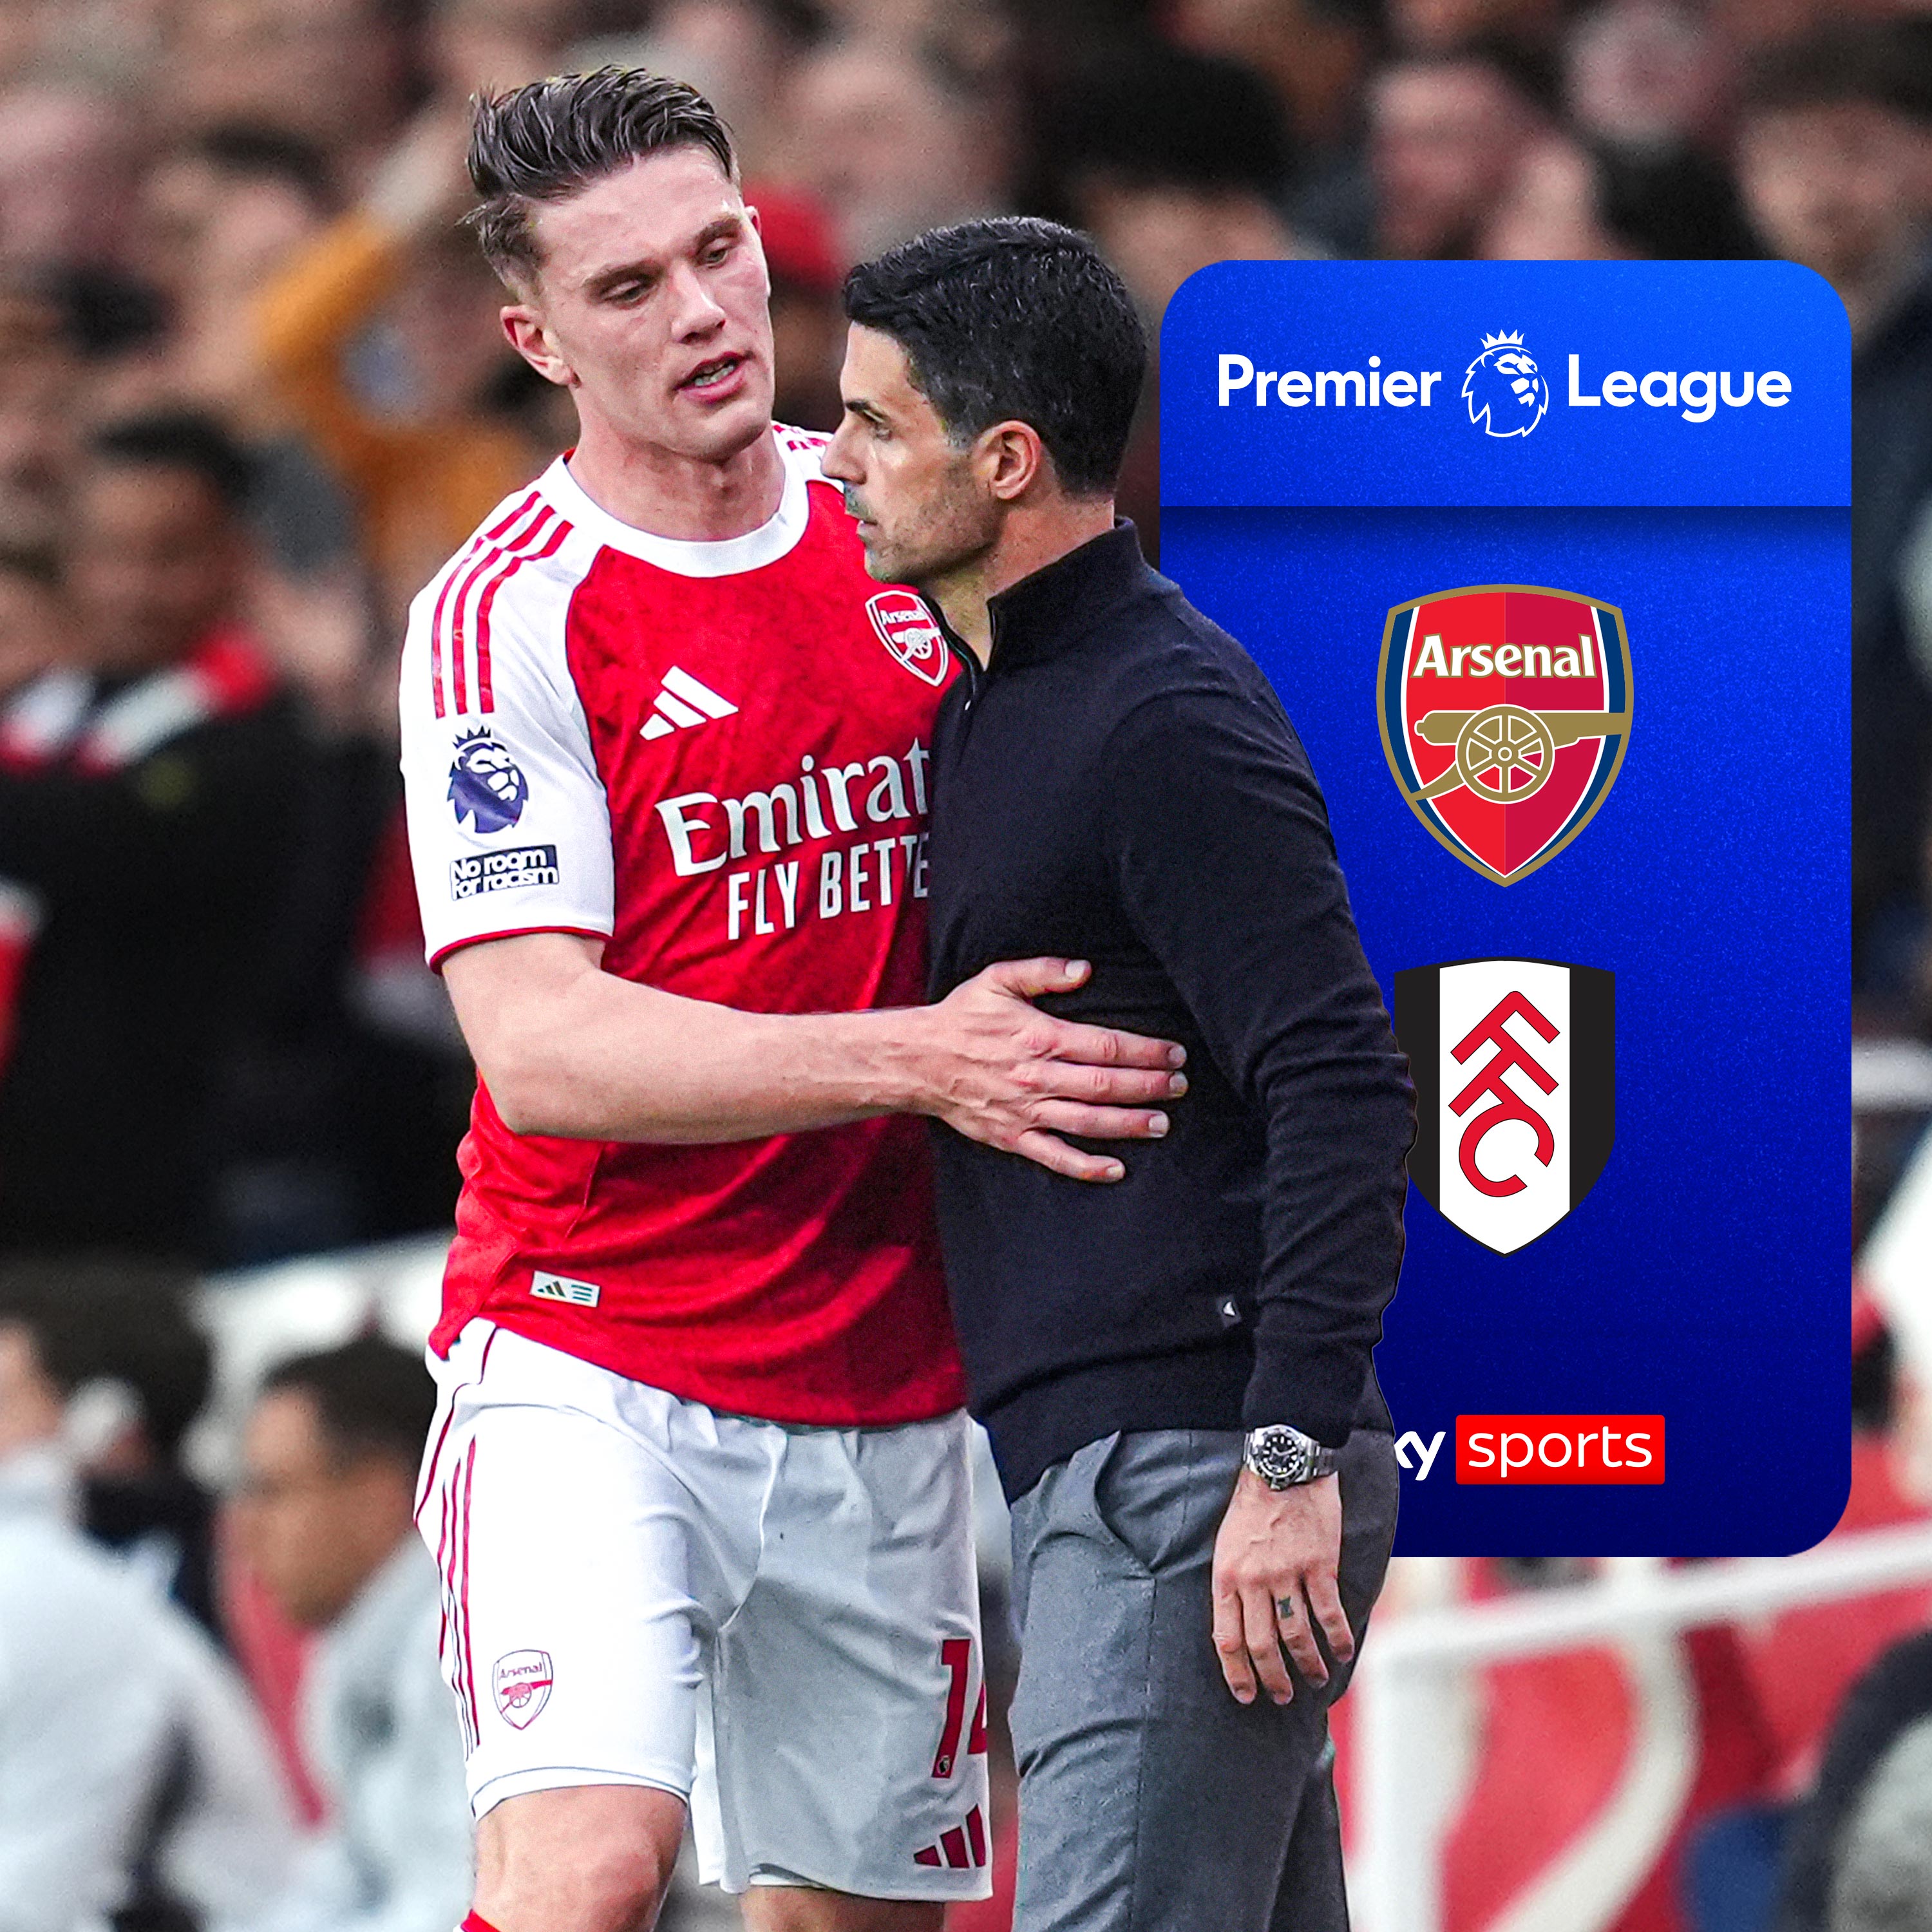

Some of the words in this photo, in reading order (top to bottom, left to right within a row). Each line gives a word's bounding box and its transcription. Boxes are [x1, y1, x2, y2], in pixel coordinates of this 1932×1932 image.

[450, 858, 482, 880] No
[484, 849, 547, 875] room
[451, 877, 480, 900] for
[484, 867, 558, 893] racism
[728, 861, 799, 940] FLY
[499, 1662, 542, 1680] Arsenal
